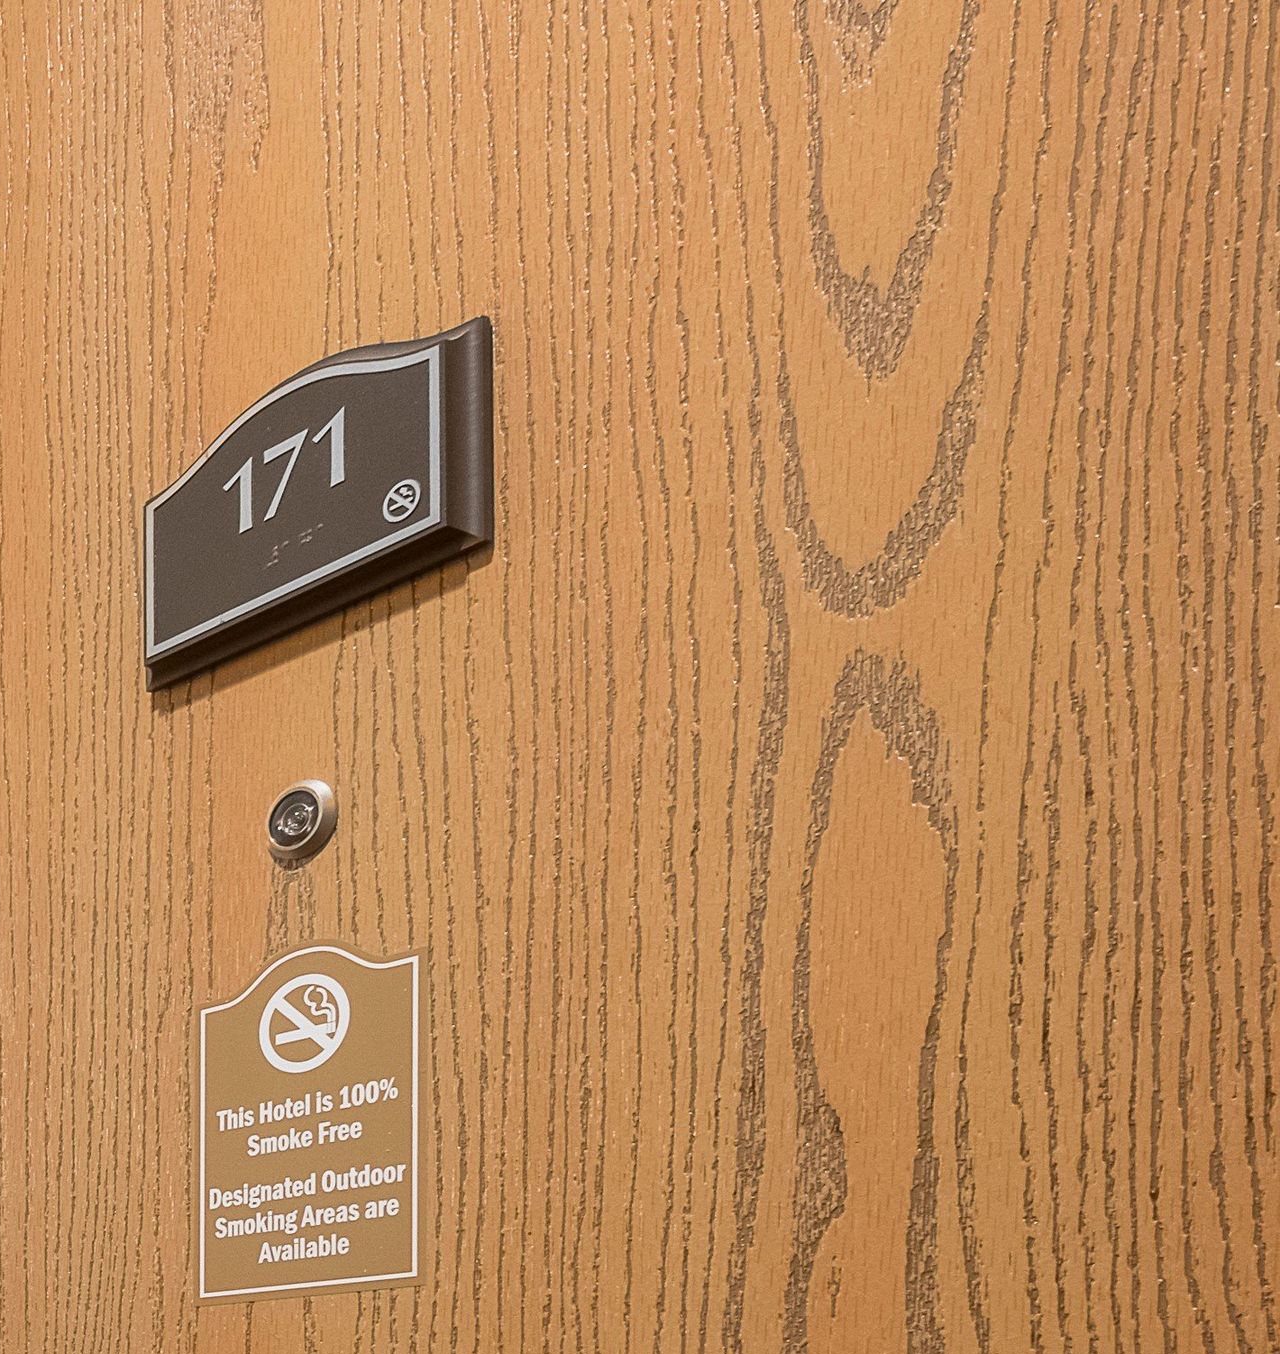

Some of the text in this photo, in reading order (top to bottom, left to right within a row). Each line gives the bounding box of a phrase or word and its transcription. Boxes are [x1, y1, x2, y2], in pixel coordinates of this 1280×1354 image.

[222, 406, 346, 535] 171
[216, 1077, 399, 1132] This Hotel is 100%
[247, 1121, 362, 1157] Smoke Free
[210, 1163, 406, 1209] Designated Outdoor
[215, 1197, 399, 1238] Smoking Areas are
[258, 1234, 350, 1264] Available
